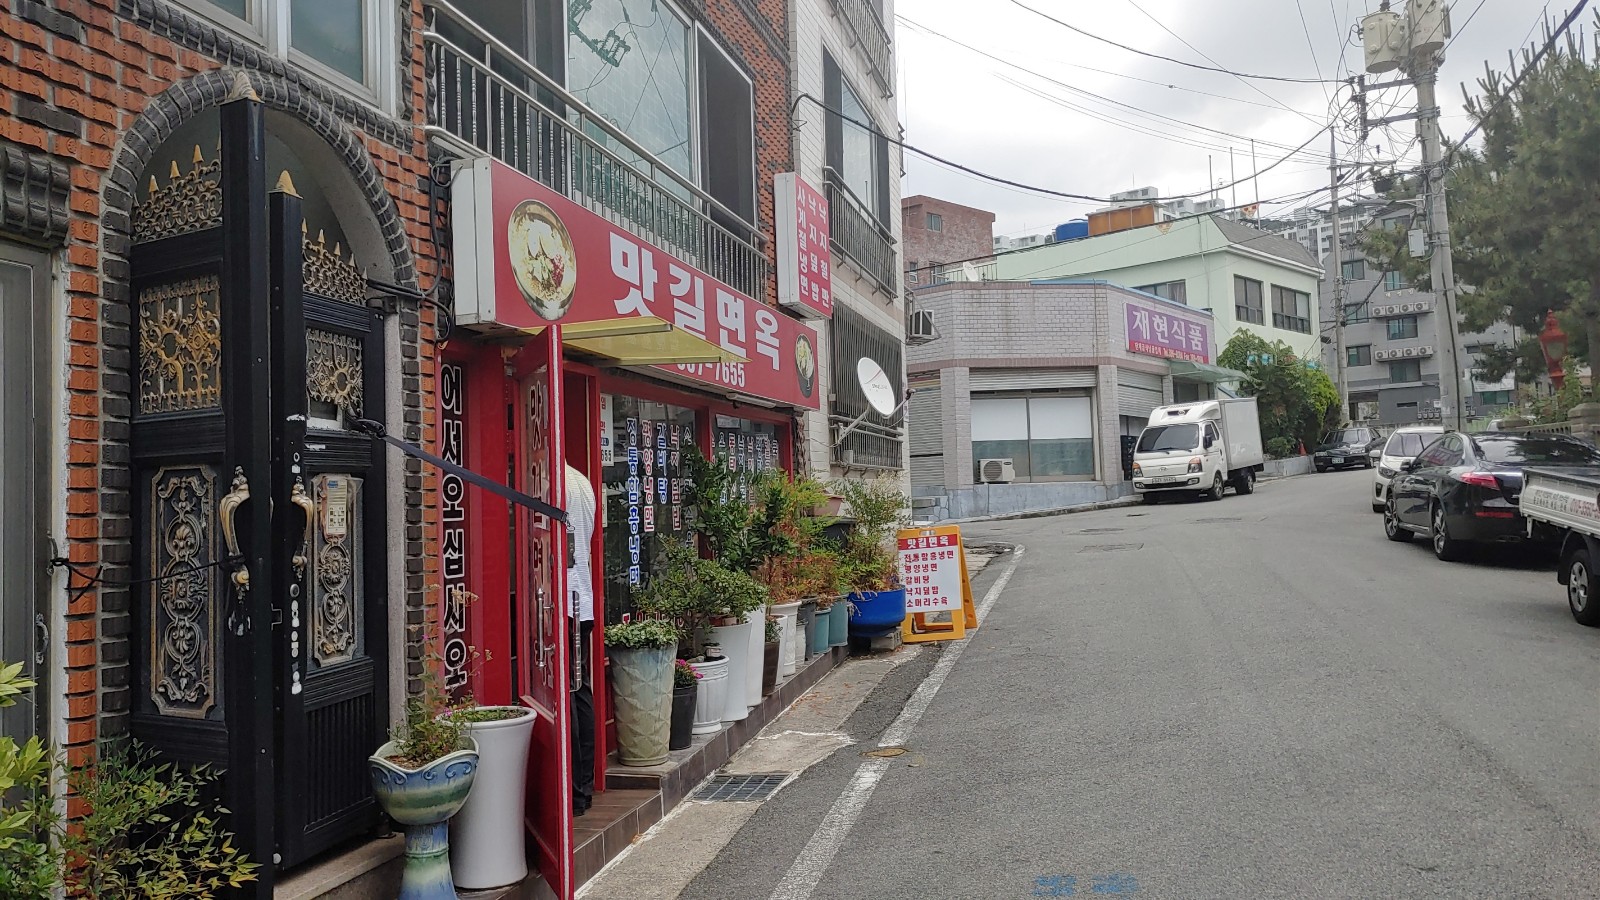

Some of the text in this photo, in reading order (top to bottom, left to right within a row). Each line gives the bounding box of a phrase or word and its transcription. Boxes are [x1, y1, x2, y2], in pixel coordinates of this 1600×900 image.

[609, 231, 779, 371] 맛길면옥
[1132, 310, 1203, 351] 재현식품
[657, 422, 668, 505] 갈비탕
[441, 363, 468, 690] 어서오십시오
[907, 535, 949, 550] 맛길면옥
[904, 563, 938, 574] 평양냉면
[905, 575, 930, 585] 갈비탕
[906, 586, 939, 596] 낙지덮밥
[906, 596, 948, 608] 소머리수육
